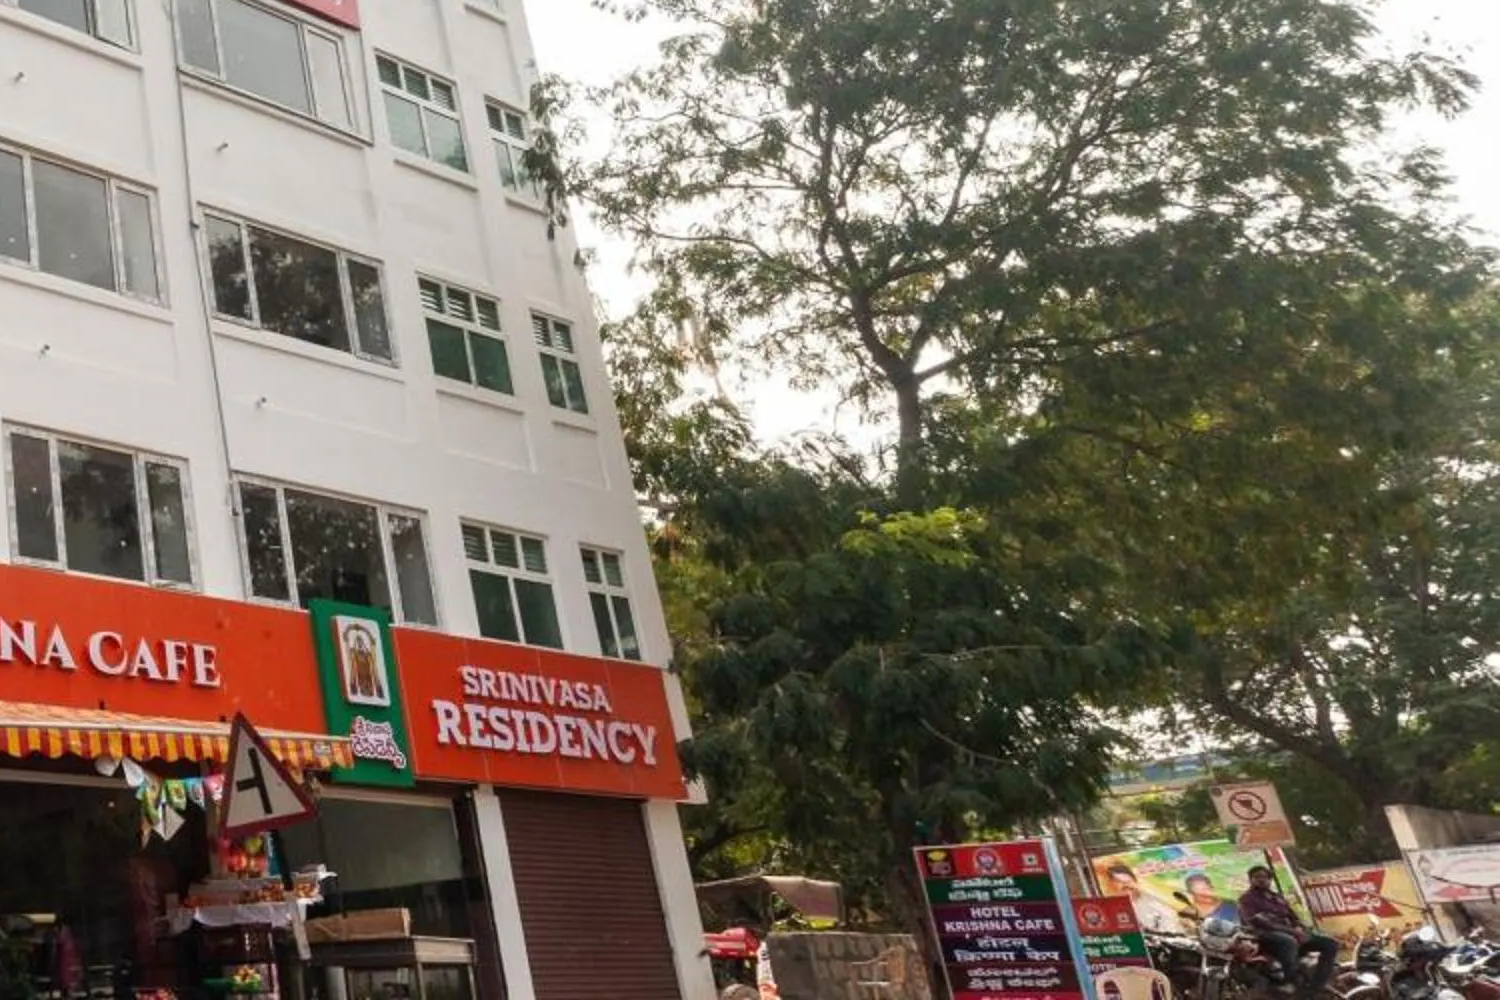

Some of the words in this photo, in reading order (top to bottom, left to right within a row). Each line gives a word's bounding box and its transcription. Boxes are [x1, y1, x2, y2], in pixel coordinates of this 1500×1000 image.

[87, 630, 222, 689] CAFE
[460, 665, 613, 713] SRINIVASA
[433, 701, 657, 765] RESIDENCY
[944, 920, 1012, 933] KRISHNA
[1015, 919, 1055, 931] CAFE
[970, 907, 1020, 918] HOTEL
